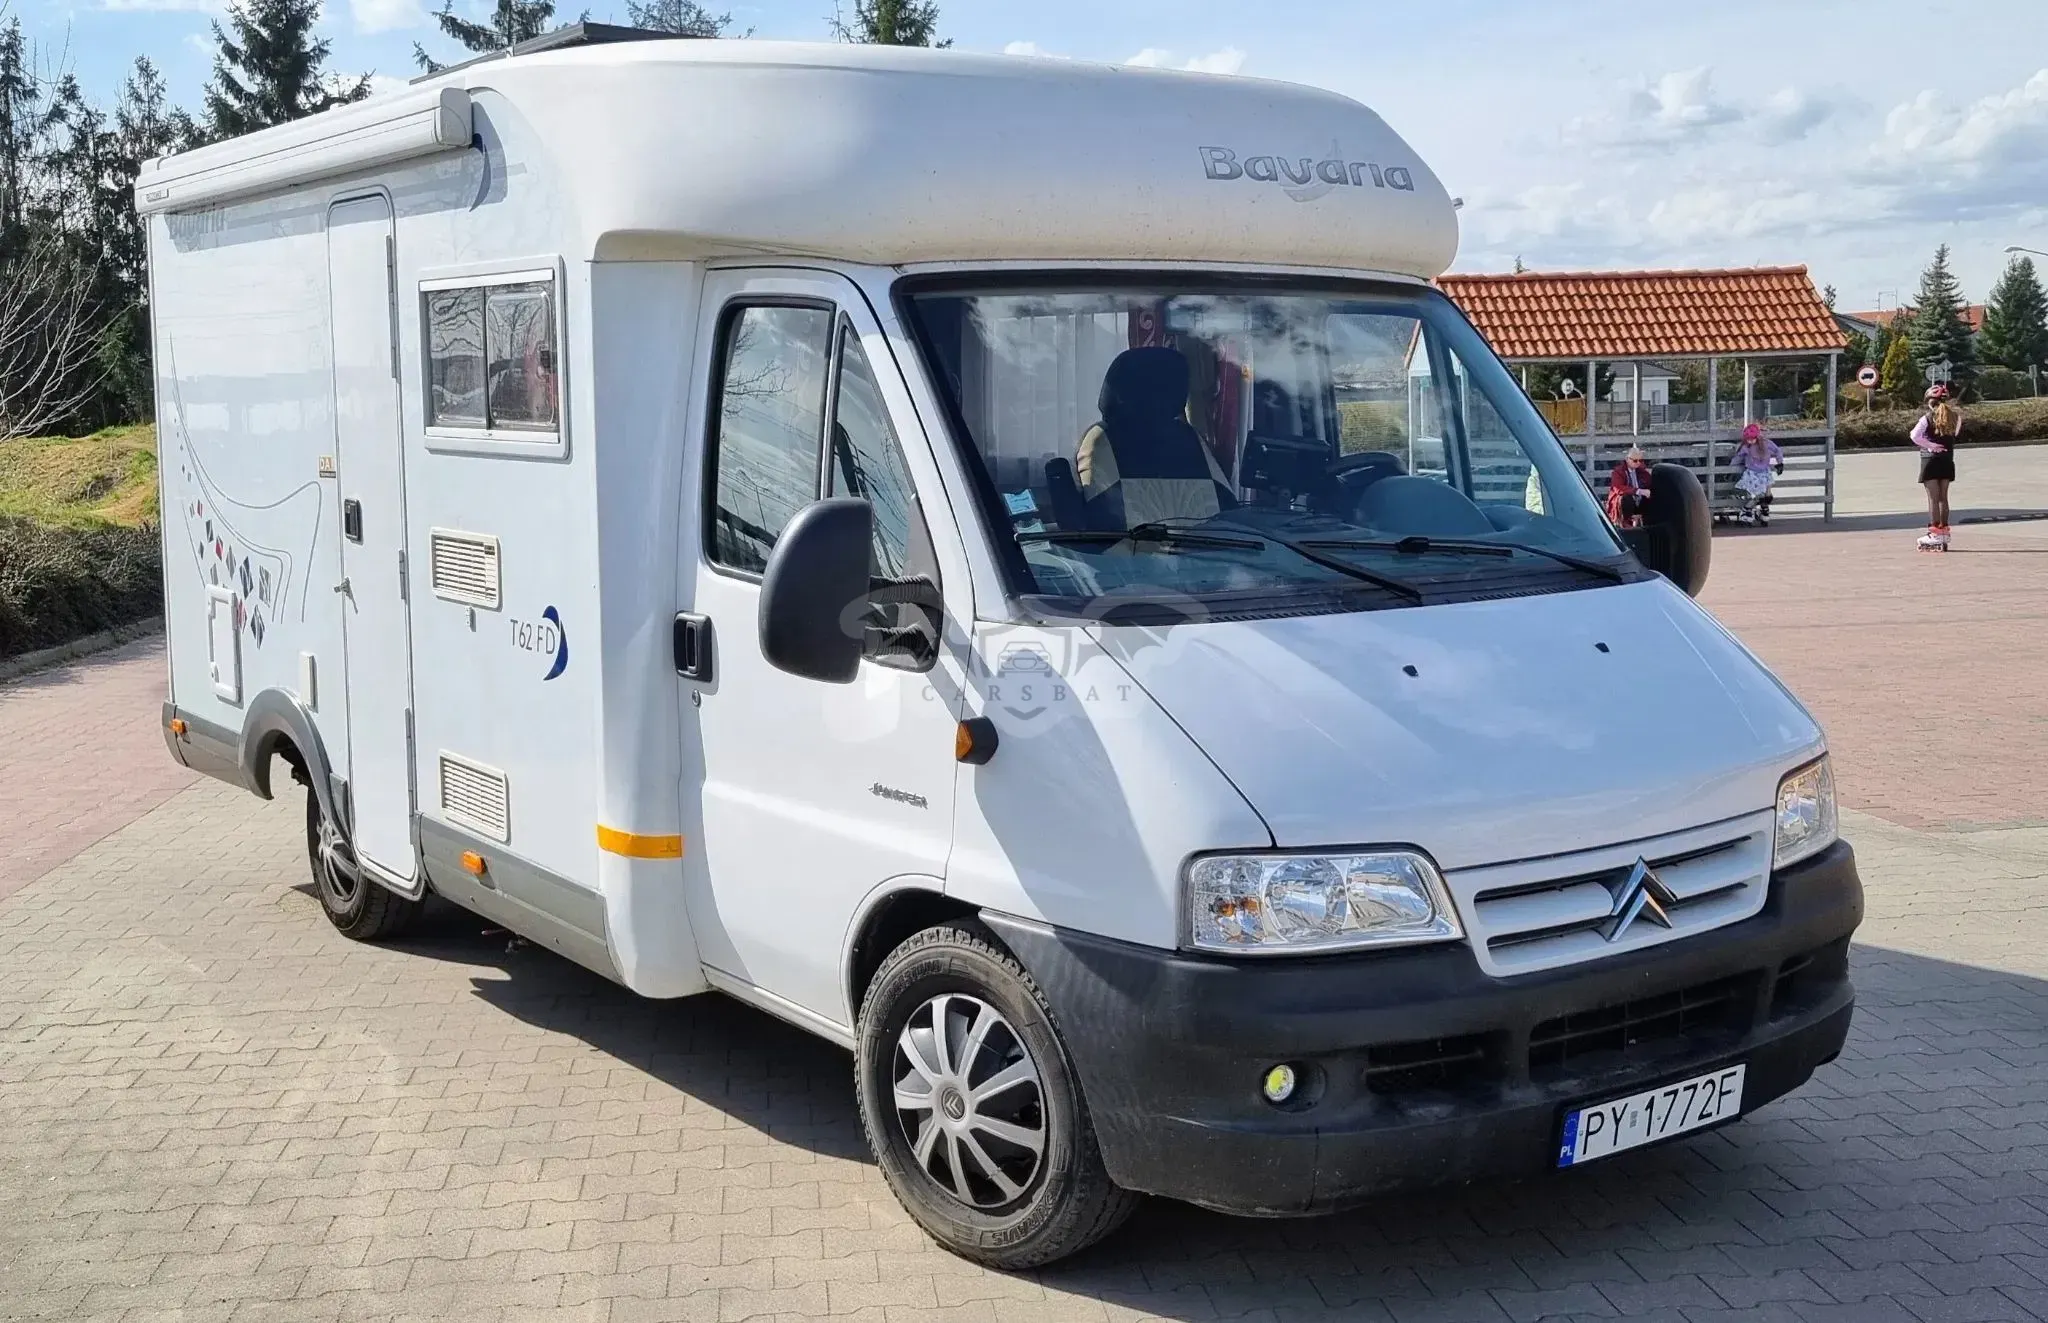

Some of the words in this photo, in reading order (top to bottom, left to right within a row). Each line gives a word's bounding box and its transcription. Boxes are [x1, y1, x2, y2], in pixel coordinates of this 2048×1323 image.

[1199, 146, 1415, 192] Bavaria
[510, 618, 533, 651] T62
[537, 625, 556, 654] FD
[1582, 1102, 1629, 1155] PY
[1644, 1071, 1737, 1137] 1772F
[1560, 1145, 1573, 1158] PL
